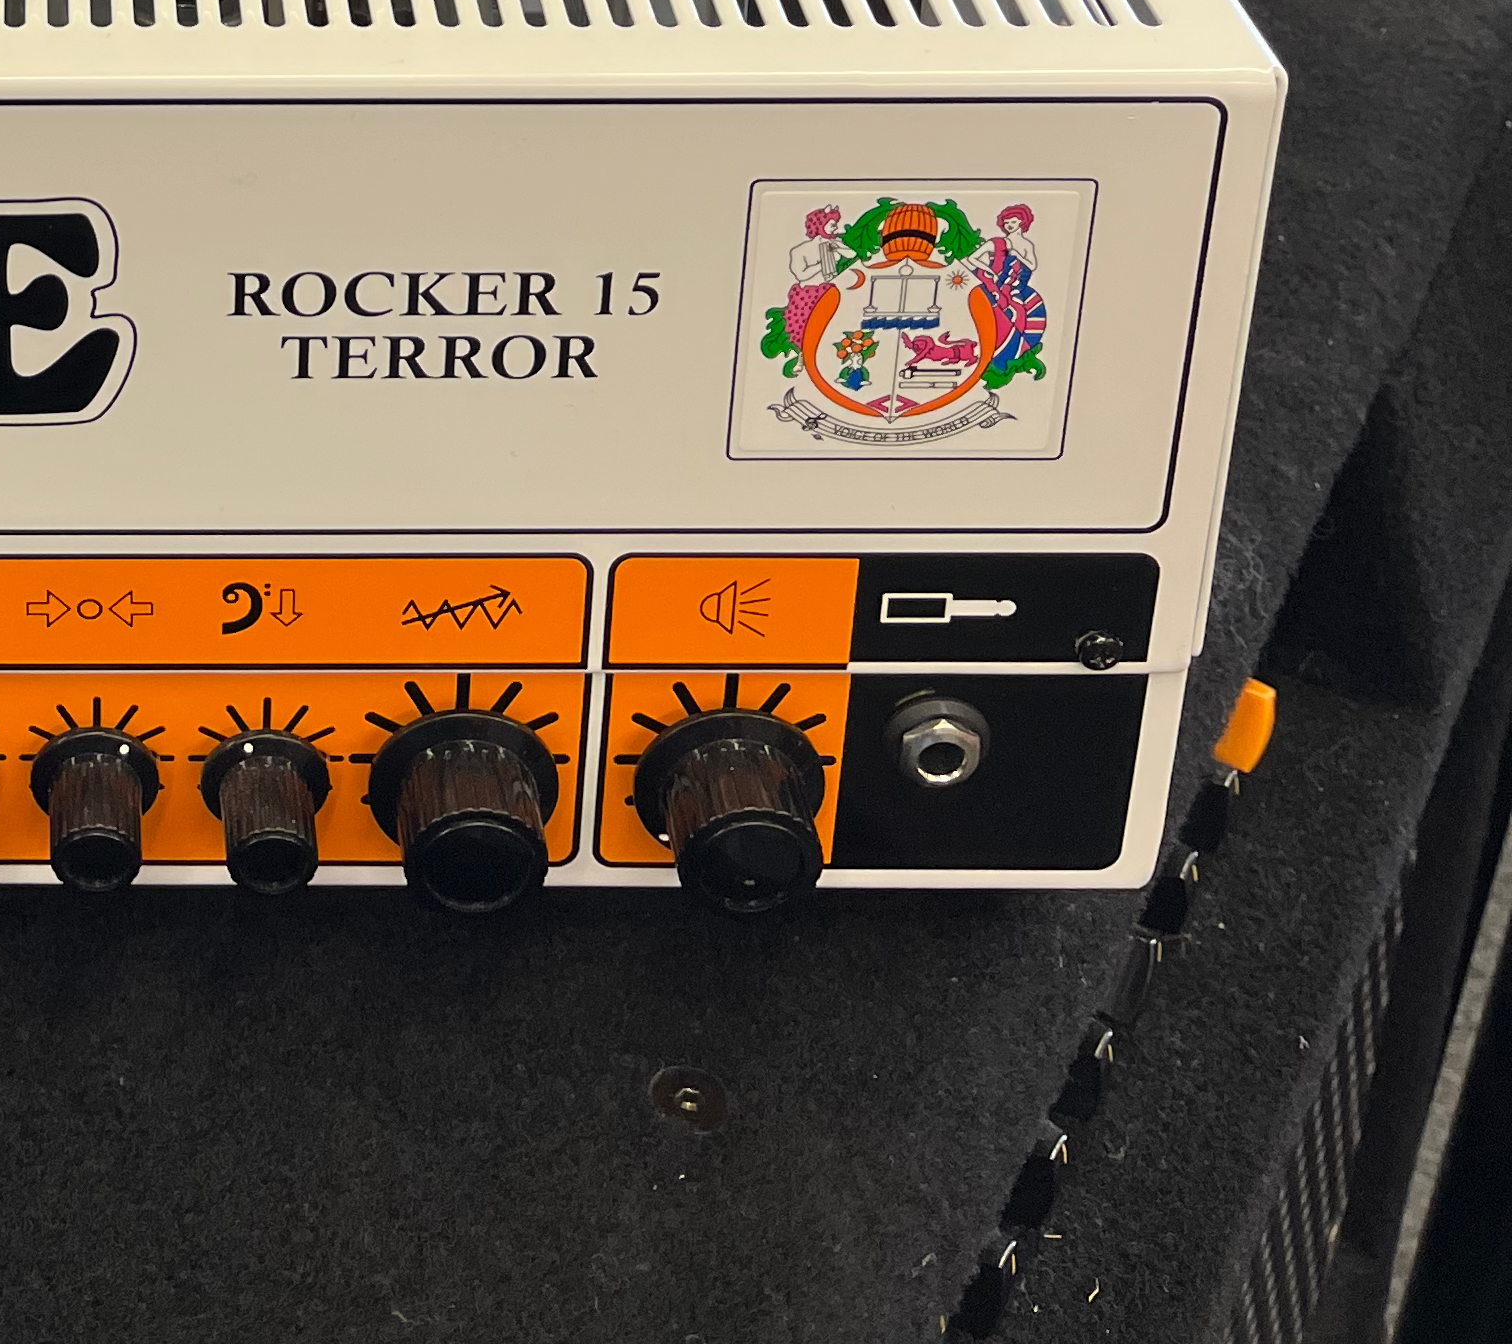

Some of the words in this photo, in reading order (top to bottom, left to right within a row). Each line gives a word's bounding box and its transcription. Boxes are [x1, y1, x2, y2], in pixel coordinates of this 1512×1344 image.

[226, 271, 562, 317] ROCKER
[594, 271, 662, 316] 15
[280, 334, 599, 380] TERROR
[833, 423, 872, 442] VOICE
[873, 431, 889, 442] OF
[892, 430, 921, 442] THE
[922, 416, 970, 439] WORLD
